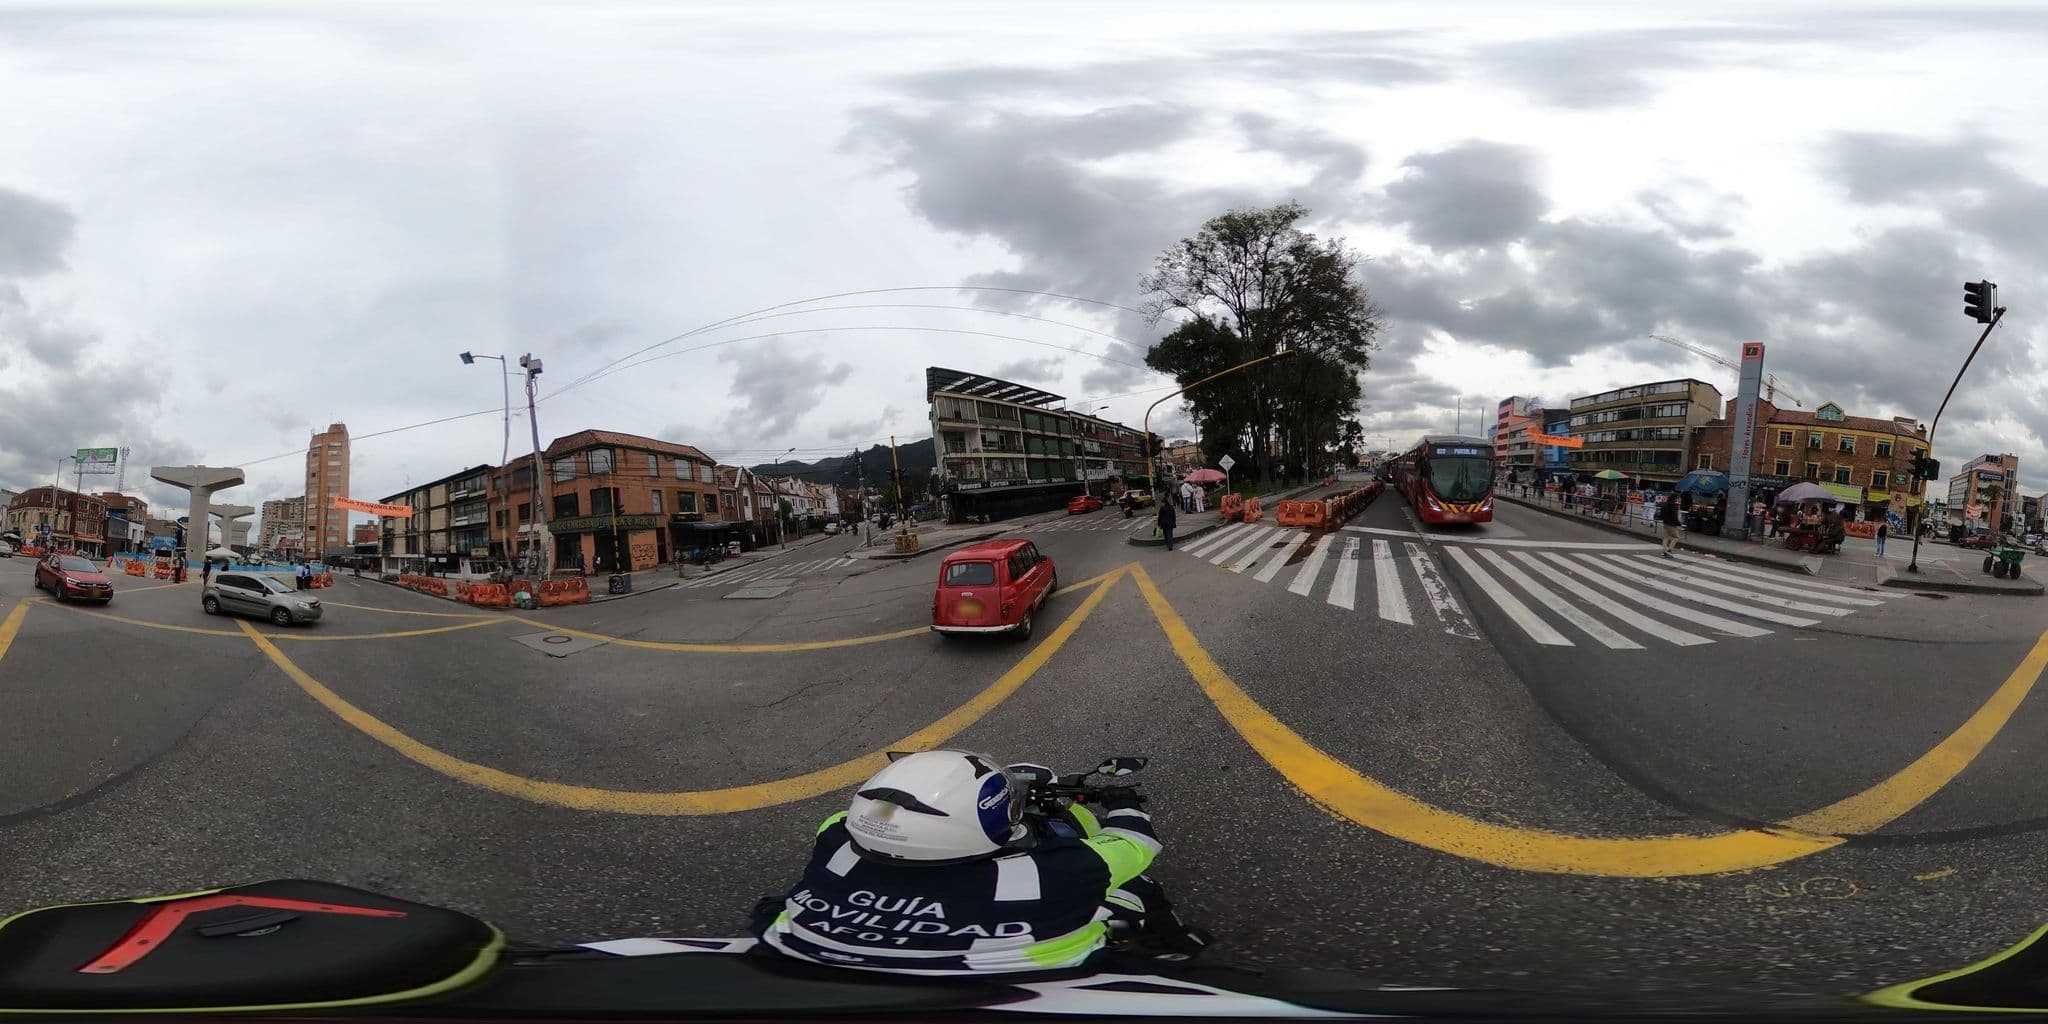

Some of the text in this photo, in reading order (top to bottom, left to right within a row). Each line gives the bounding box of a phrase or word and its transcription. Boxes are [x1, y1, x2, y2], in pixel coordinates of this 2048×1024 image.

[793, 889, 1033, 937] MOVILIDAD
[848, 890, 946, 919] GUÍA
[808, 920, 911, 945] AF01
